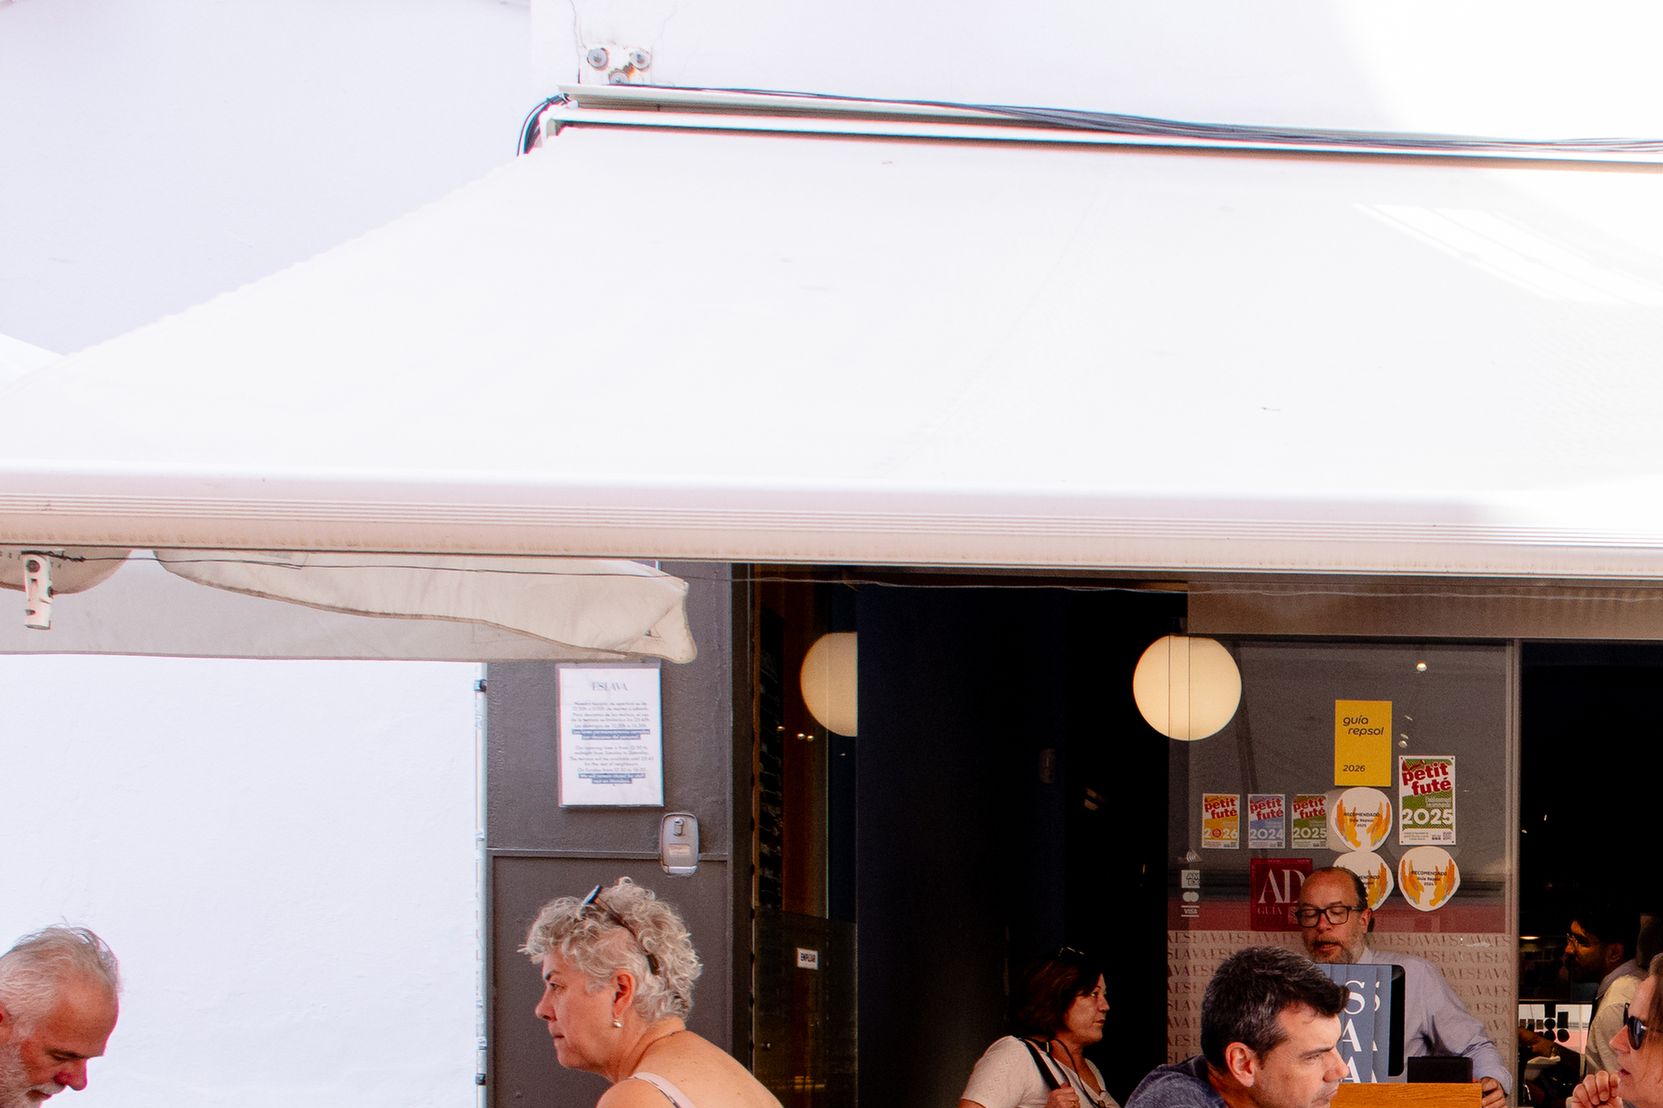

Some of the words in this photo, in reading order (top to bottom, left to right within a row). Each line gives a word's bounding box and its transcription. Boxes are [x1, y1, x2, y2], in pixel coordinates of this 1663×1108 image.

[1342, 715, 1369, 727] guía
[1347, 726, 1384, 737] repsol
[1342, 764, 1366, 772] 2026
[1402, 762, 1449, 786] petit
[1411, 776, 1452, 796] futé
[1204, 797, 1236, 813] petit
[1249, 797, 1282, 814] petit
[1293, 797, 1325, 813] petit
[1402, 808, 1453, 825] 2025
[1249, 828, 1284, 839] 2024
[1293, 827, 1327, 838] 2025
